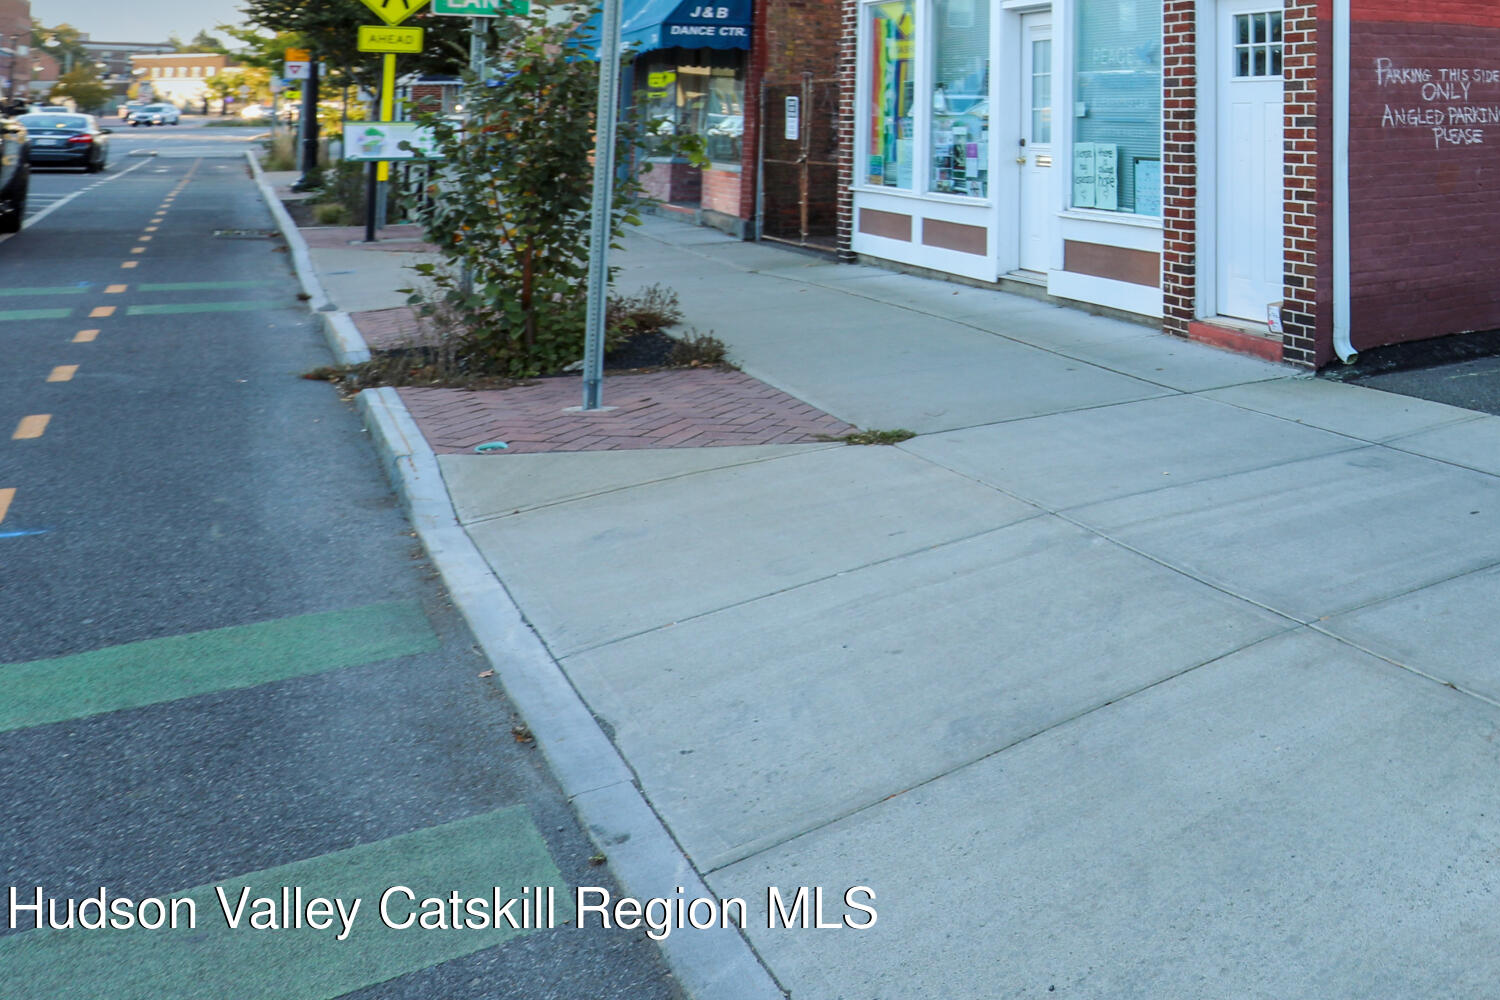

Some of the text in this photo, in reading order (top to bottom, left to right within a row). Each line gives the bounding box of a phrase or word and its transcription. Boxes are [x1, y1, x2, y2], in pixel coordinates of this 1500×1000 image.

[367, 33, 414, 45] AHEAD
[670, 25, 748, 37] DANCE CTR.
[1438, 68, 1469, 82] THIS
[1472, 69, 1500, 82] SIDE
[1422, 82, 1471, 103] ONLY
[1381, 104, 1445, 127] ANGLED
[1432, 127, 1484, 150] PLEASE
